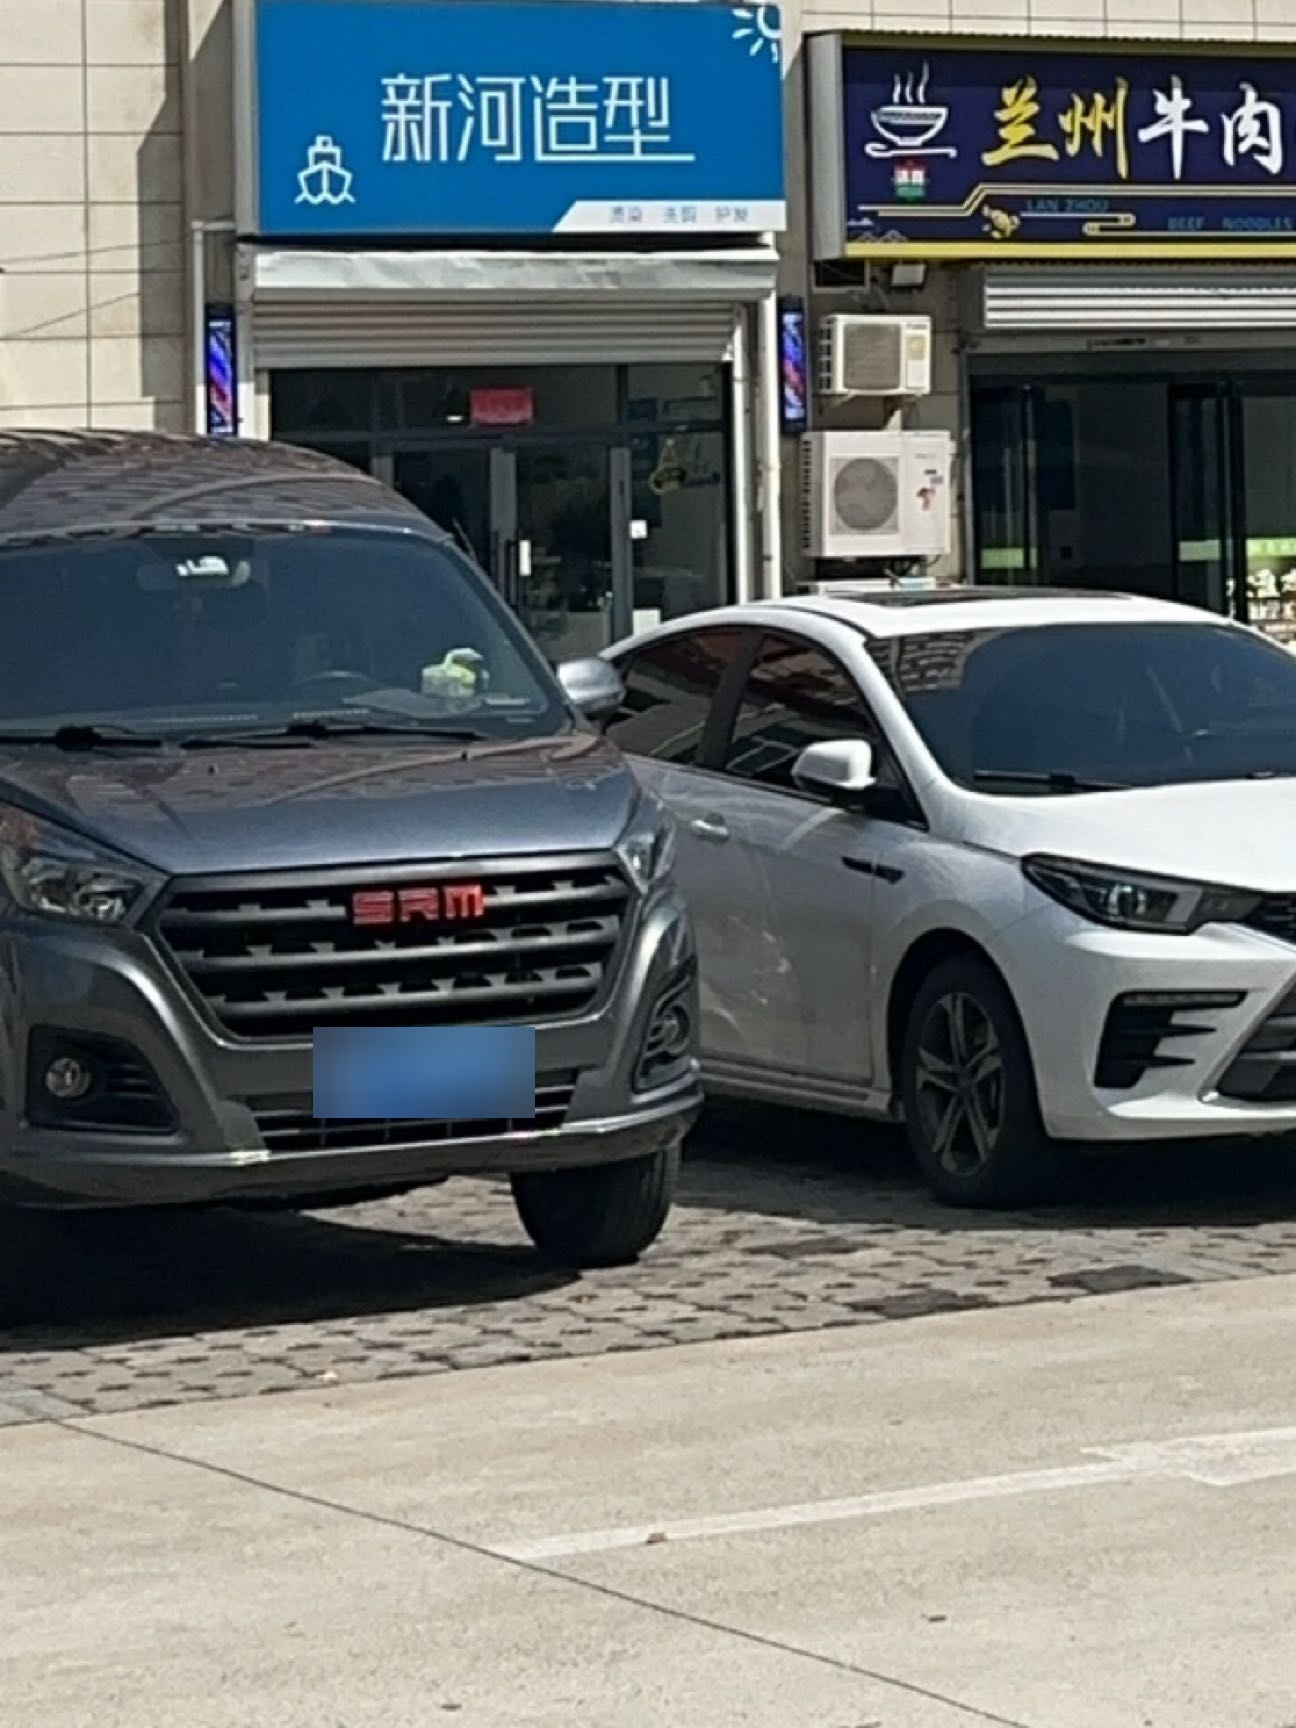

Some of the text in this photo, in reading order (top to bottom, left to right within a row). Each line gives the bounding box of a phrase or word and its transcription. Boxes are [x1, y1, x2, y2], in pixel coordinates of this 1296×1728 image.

[382, 73, 695, 163] 新河造型
[352, 884, 484, 925] SRM
